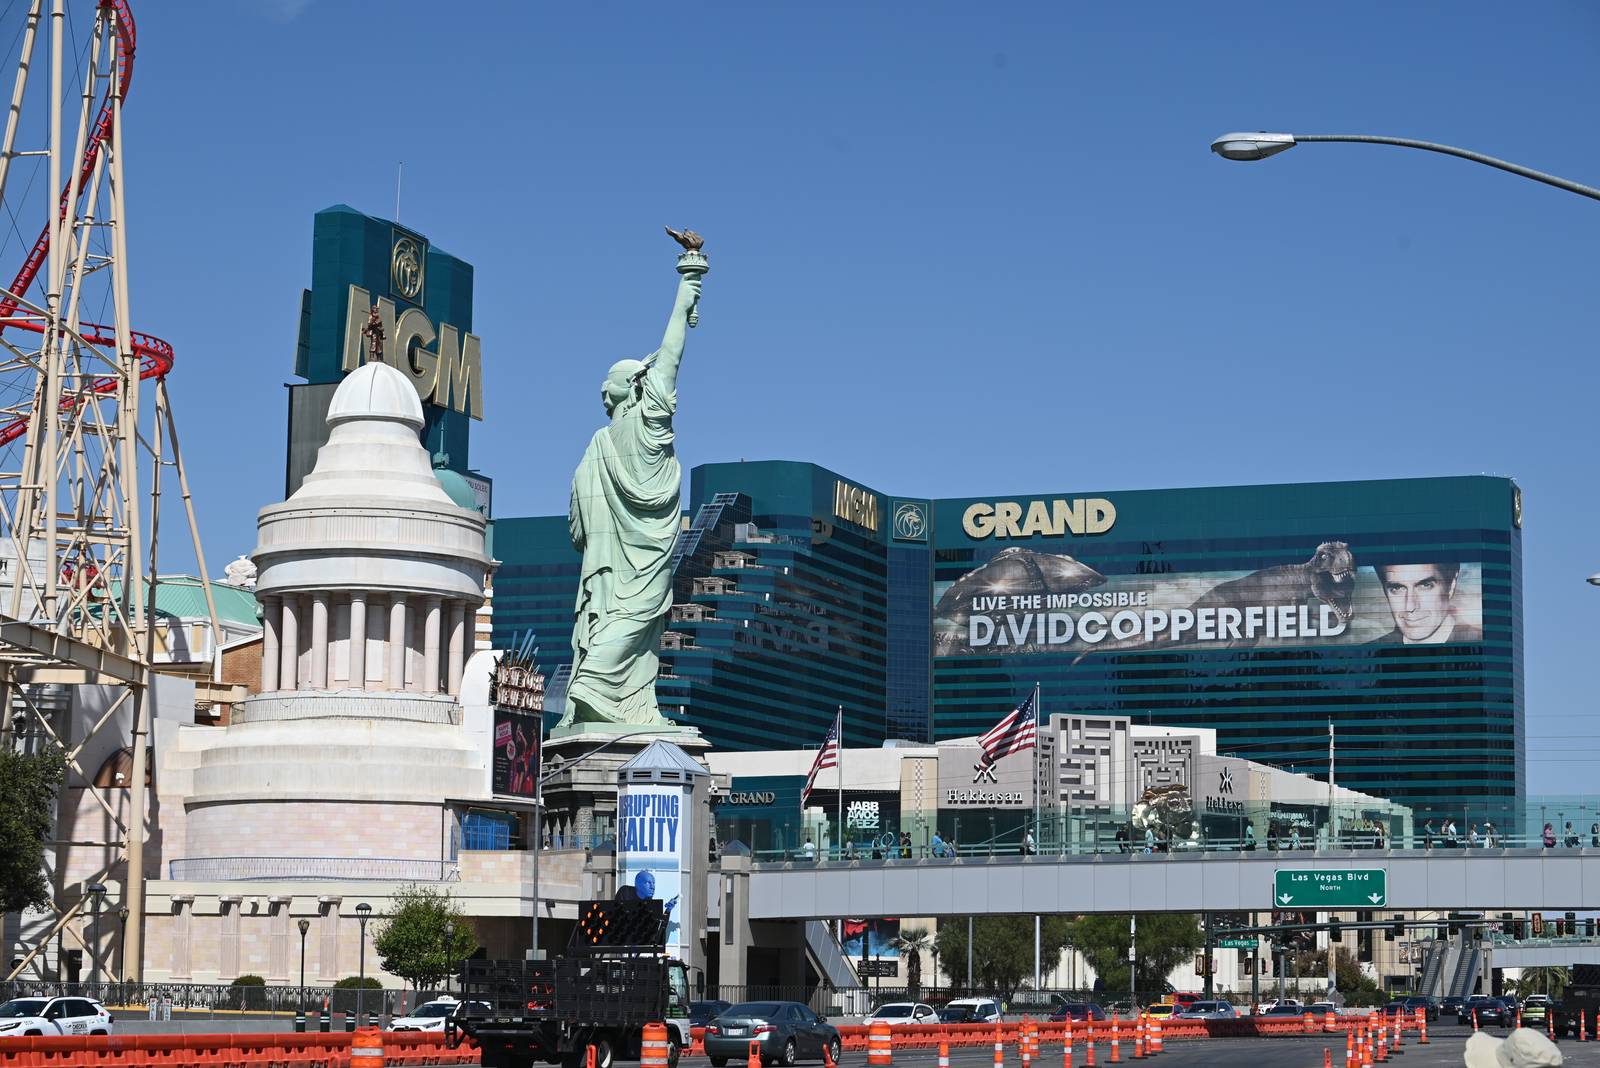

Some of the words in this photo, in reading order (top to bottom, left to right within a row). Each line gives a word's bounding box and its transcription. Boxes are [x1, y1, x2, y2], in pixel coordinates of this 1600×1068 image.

[342, 284, 483, 422] MGM
[832, 480, 878, 532] MGM
[962, 498, 1117, 538] GRAND
[972, 596, 1006, 611] LIVE
[1011, 594, 1041, 610] THE
[1046, 591, 1149, 609] IMPOSSIBLE
[729, 792, 775, 804] GRAND
[947, 788, 1023, 802] Hakkasan
[847, 801, 879, 811] JABB
[847, 810, 879, 819] AWOC
[846, 818, 880, 828] KEEZ
[1291, 873, 1308, 881] Las
[1314, 873, 1343, 883] Vegas
[1347, 873, 1369, 881] Blvd
